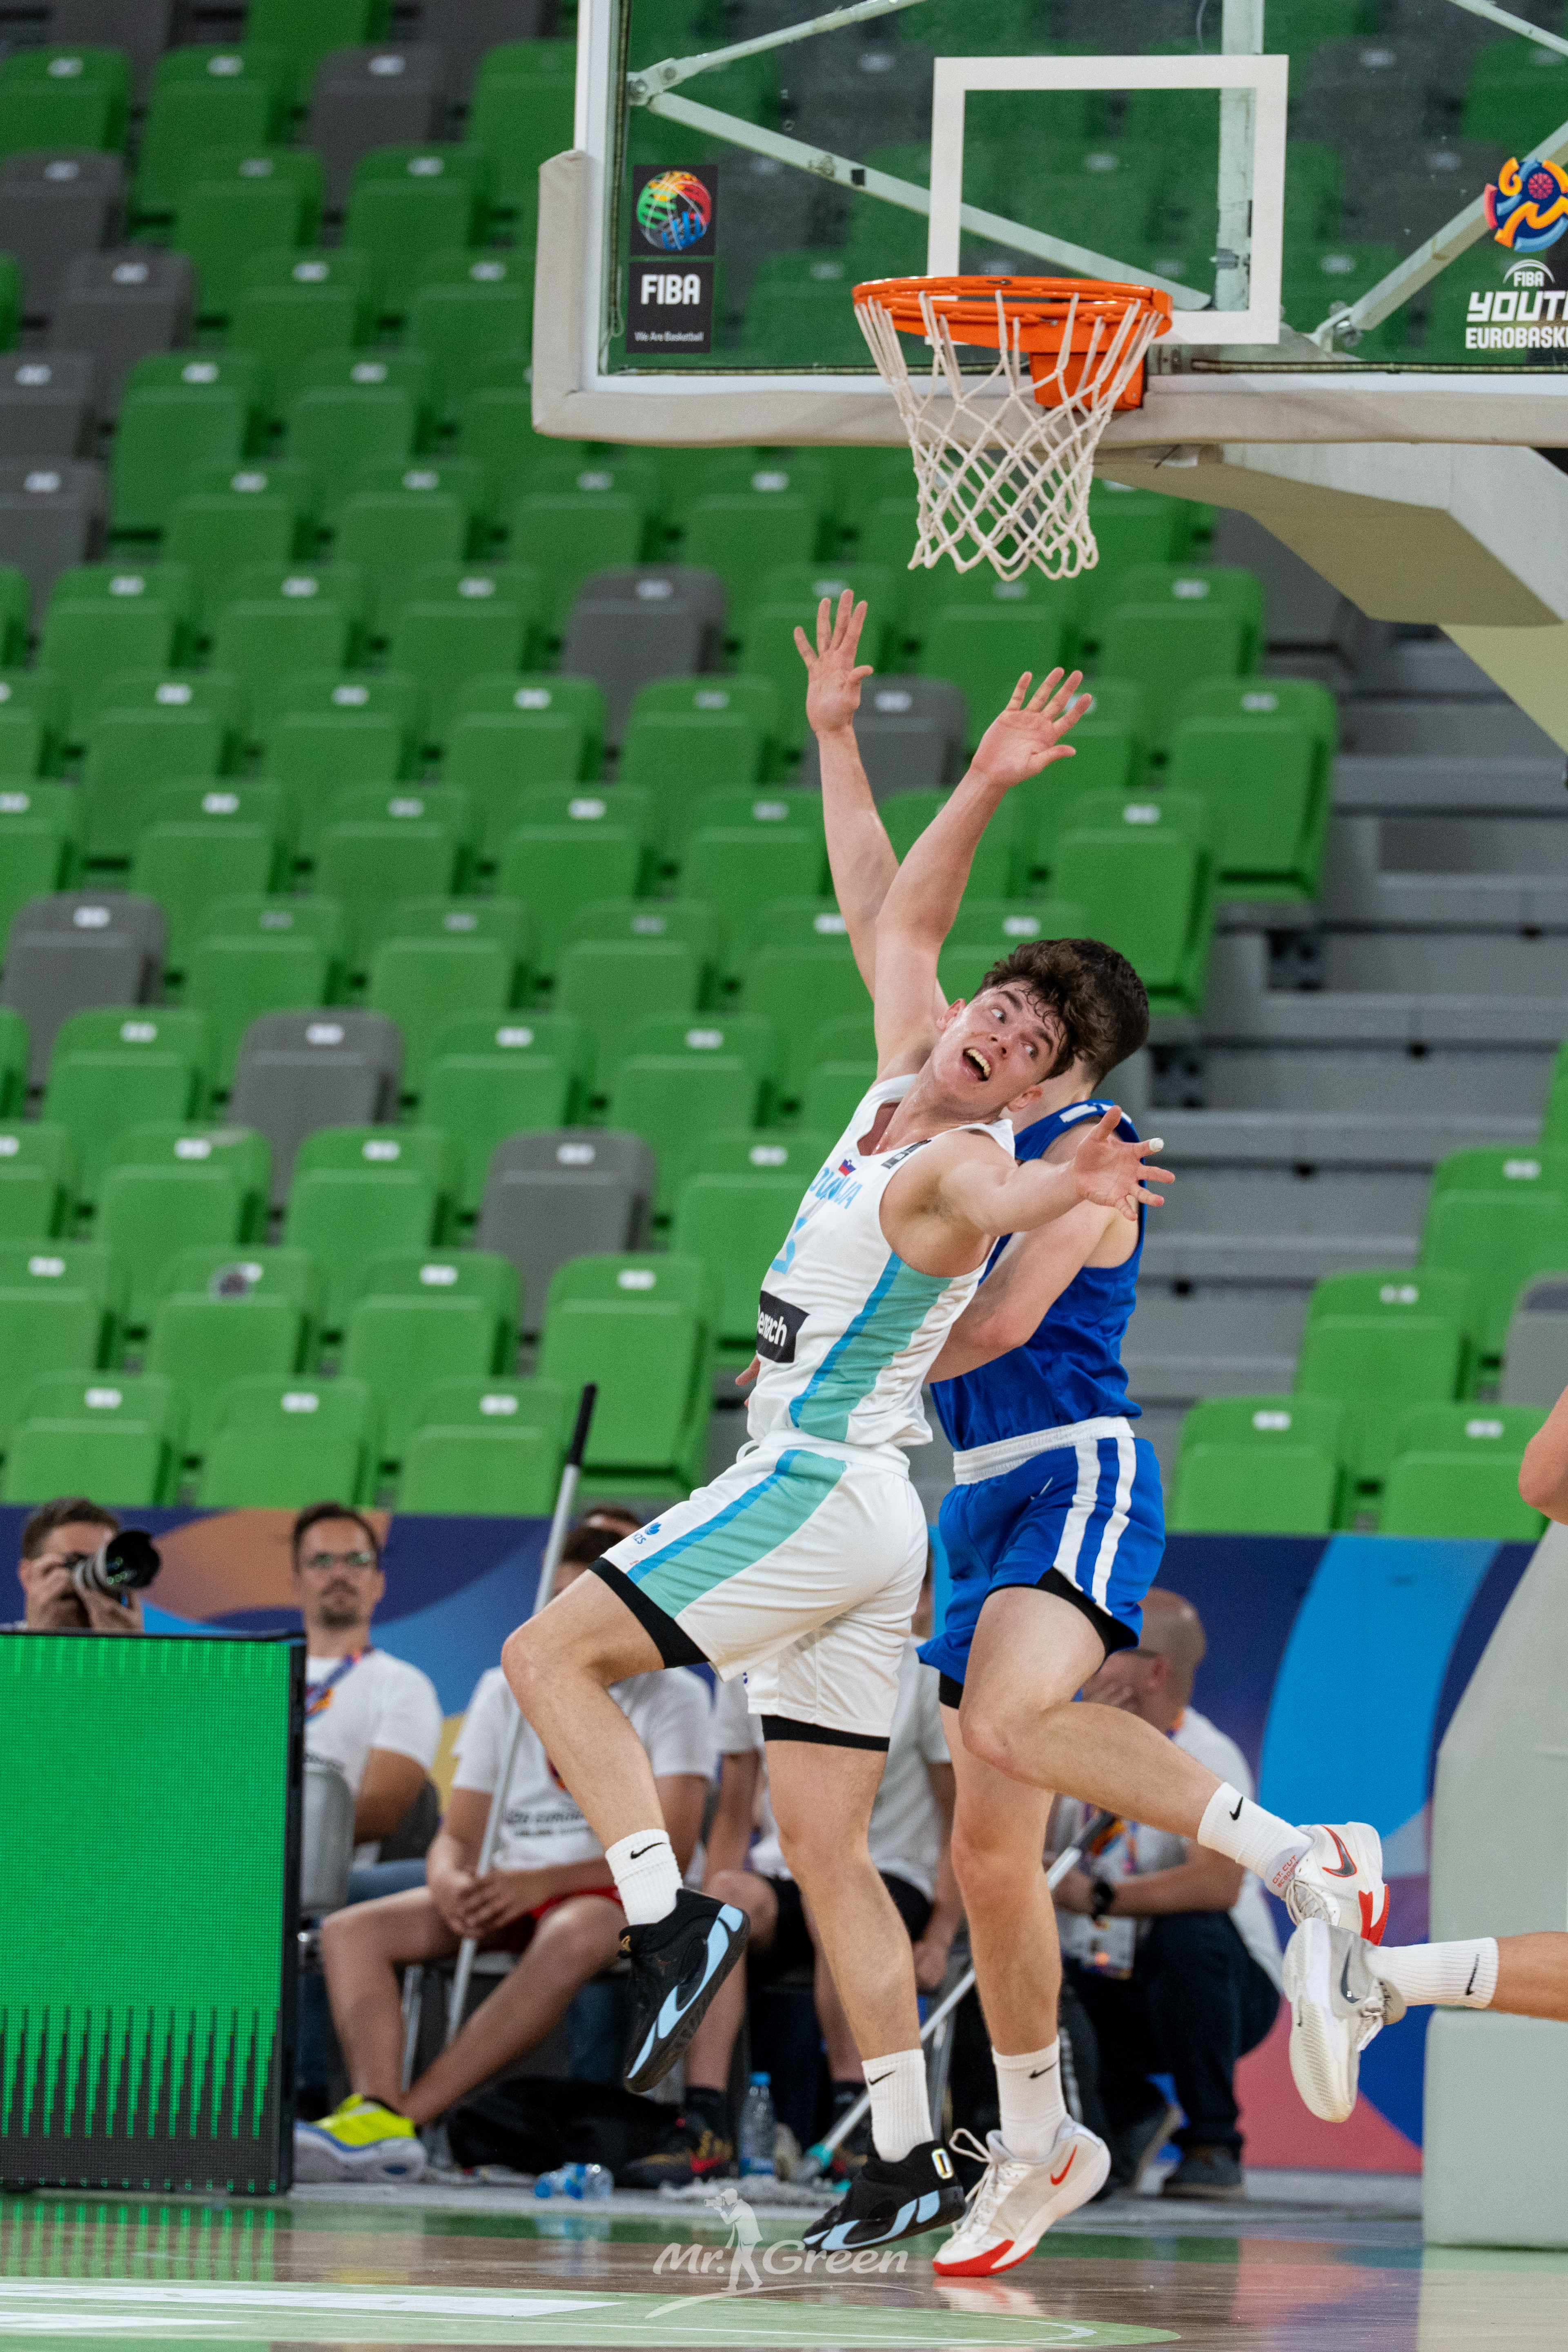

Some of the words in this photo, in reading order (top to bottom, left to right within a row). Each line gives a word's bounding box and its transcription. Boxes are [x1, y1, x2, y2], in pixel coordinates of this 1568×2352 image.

[640, 274, 701, 305] FIBA
[1513, 271, 1544, 287] FIBA
[1466, 290, 1568, 322] YOUT
[1465, 326, 1568, 348] EUROBASK
[1282, 1854, 1296, 1871] CUT
